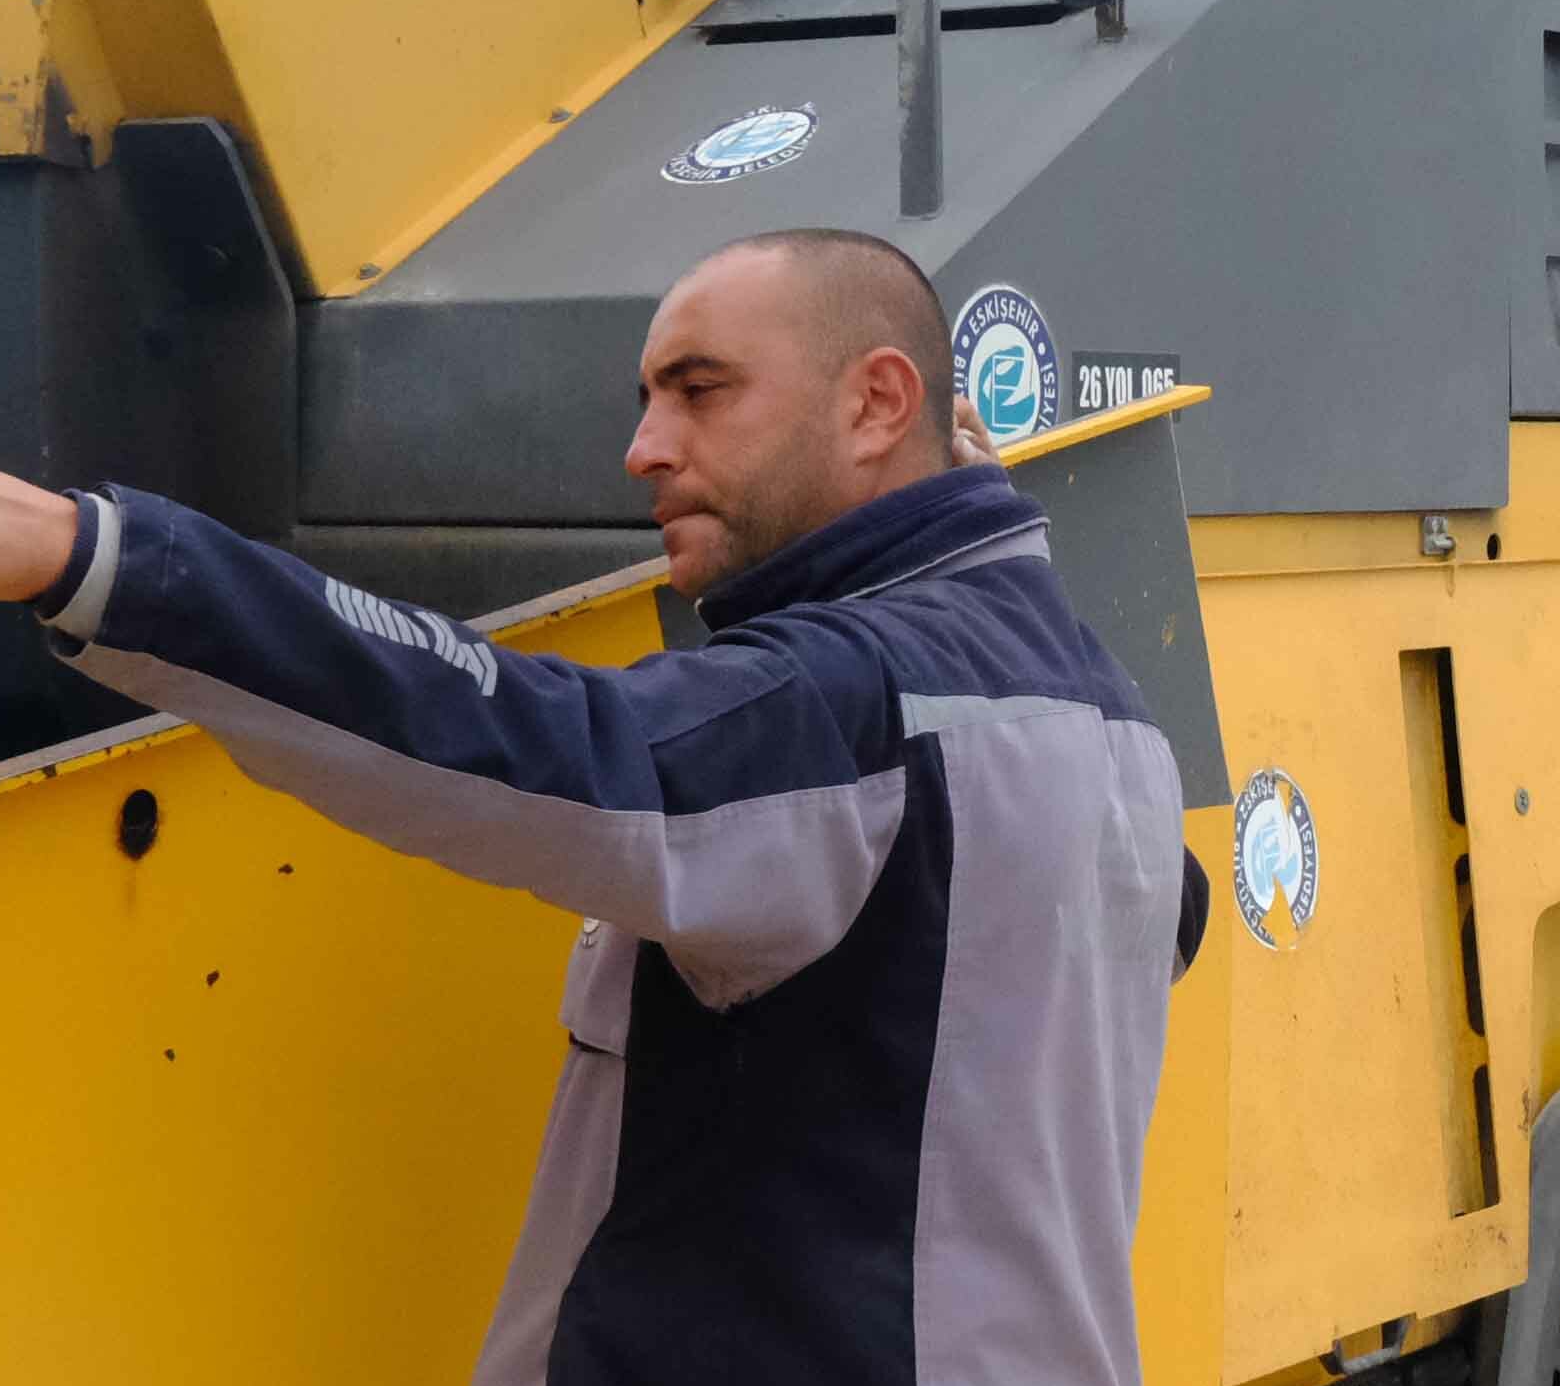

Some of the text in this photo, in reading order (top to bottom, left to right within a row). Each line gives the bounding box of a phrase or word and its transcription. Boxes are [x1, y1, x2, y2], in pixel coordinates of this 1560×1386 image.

[968, 293, 1040, 340] ESKİŞEHİR
[1079, 365, 1102, 408] 26
[1105, 366, 1133, 407] YOL
